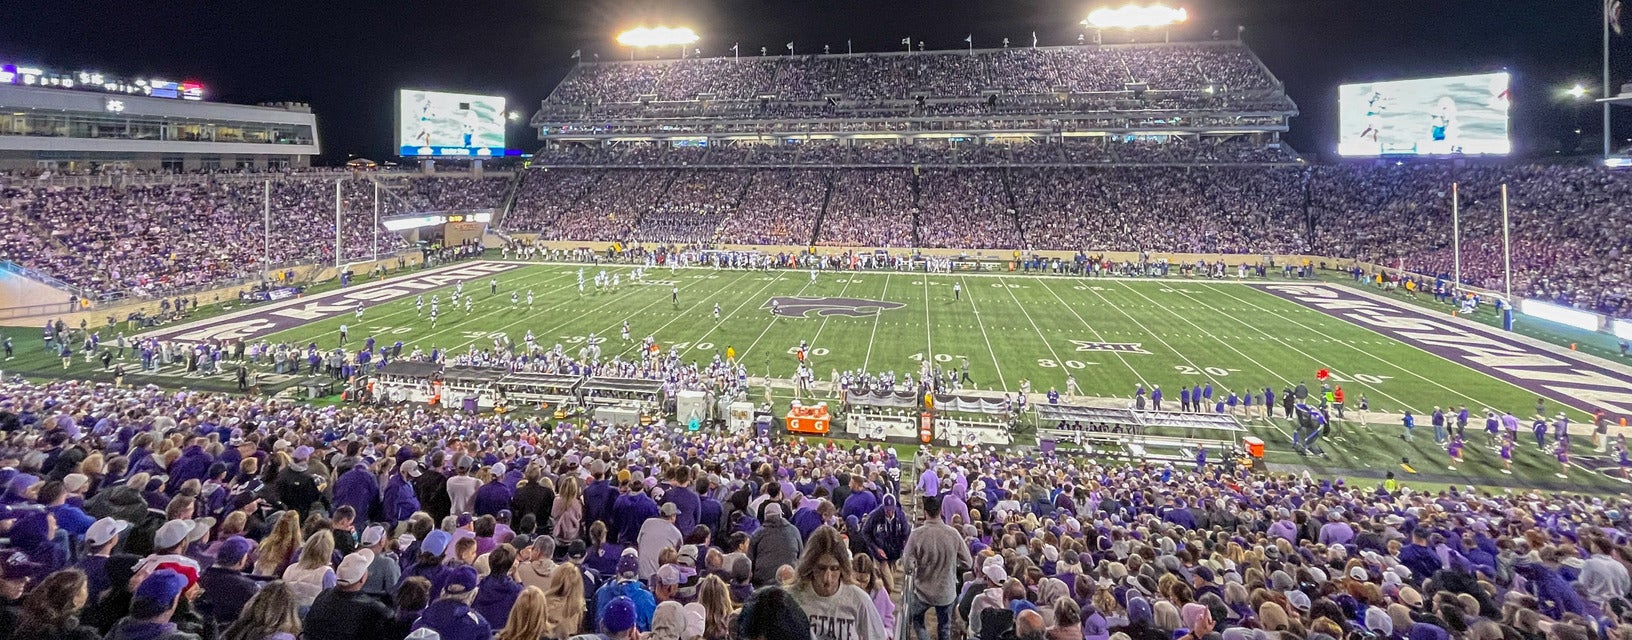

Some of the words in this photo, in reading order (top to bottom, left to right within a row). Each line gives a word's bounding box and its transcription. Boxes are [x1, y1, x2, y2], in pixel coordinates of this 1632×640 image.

[270, 263, 518, 320] K-STATE
[908, 353, 952, 361] 40
[1037, 359, 1086, 369] 30
[1174, 366, 1230, 377] 20
[790, 419, 799, 429] G
[814, 421, 823, 431] G
[809, 615, 855, 640] STATE
